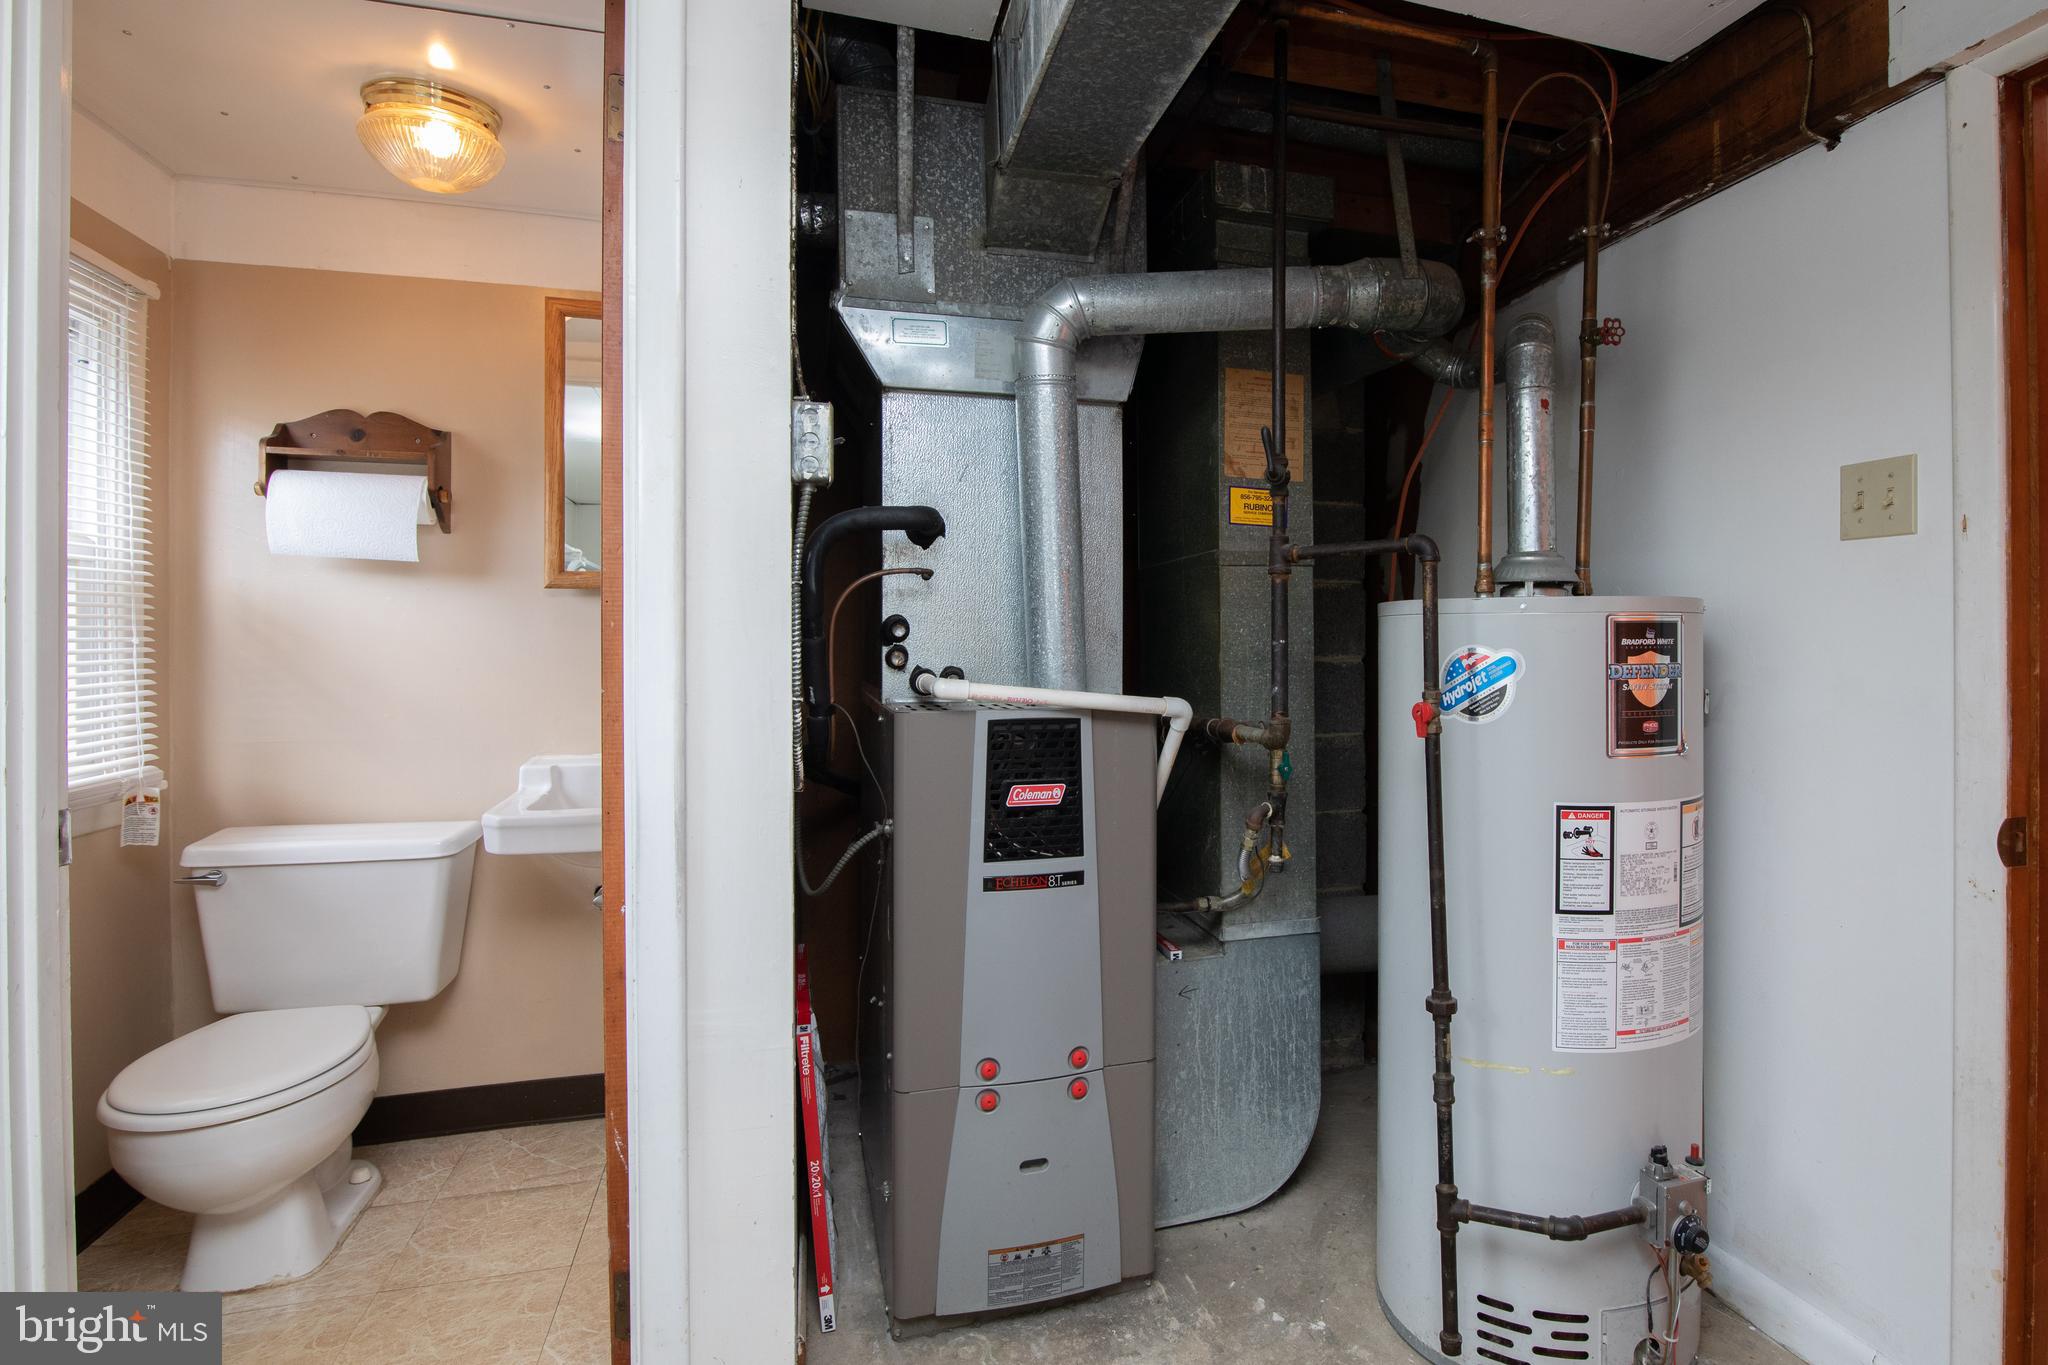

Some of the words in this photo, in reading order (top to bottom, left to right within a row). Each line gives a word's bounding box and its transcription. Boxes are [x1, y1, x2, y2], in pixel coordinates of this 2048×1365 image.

[1243, 503, 1273, 512] RUBINO
[1609, 663, 1682, 679] DEFENDER
[1442, 671, 1488, 707] Hydrojet
[1013, 788, 1052, 801] Coleman
[996, 876, 1047, 891] ECHELON
[800, 1035, 810, 1075] Filtrete
[810, 1160, 822, 1198] 20x20x1
[824, 1314, 833, 1330] 3M
